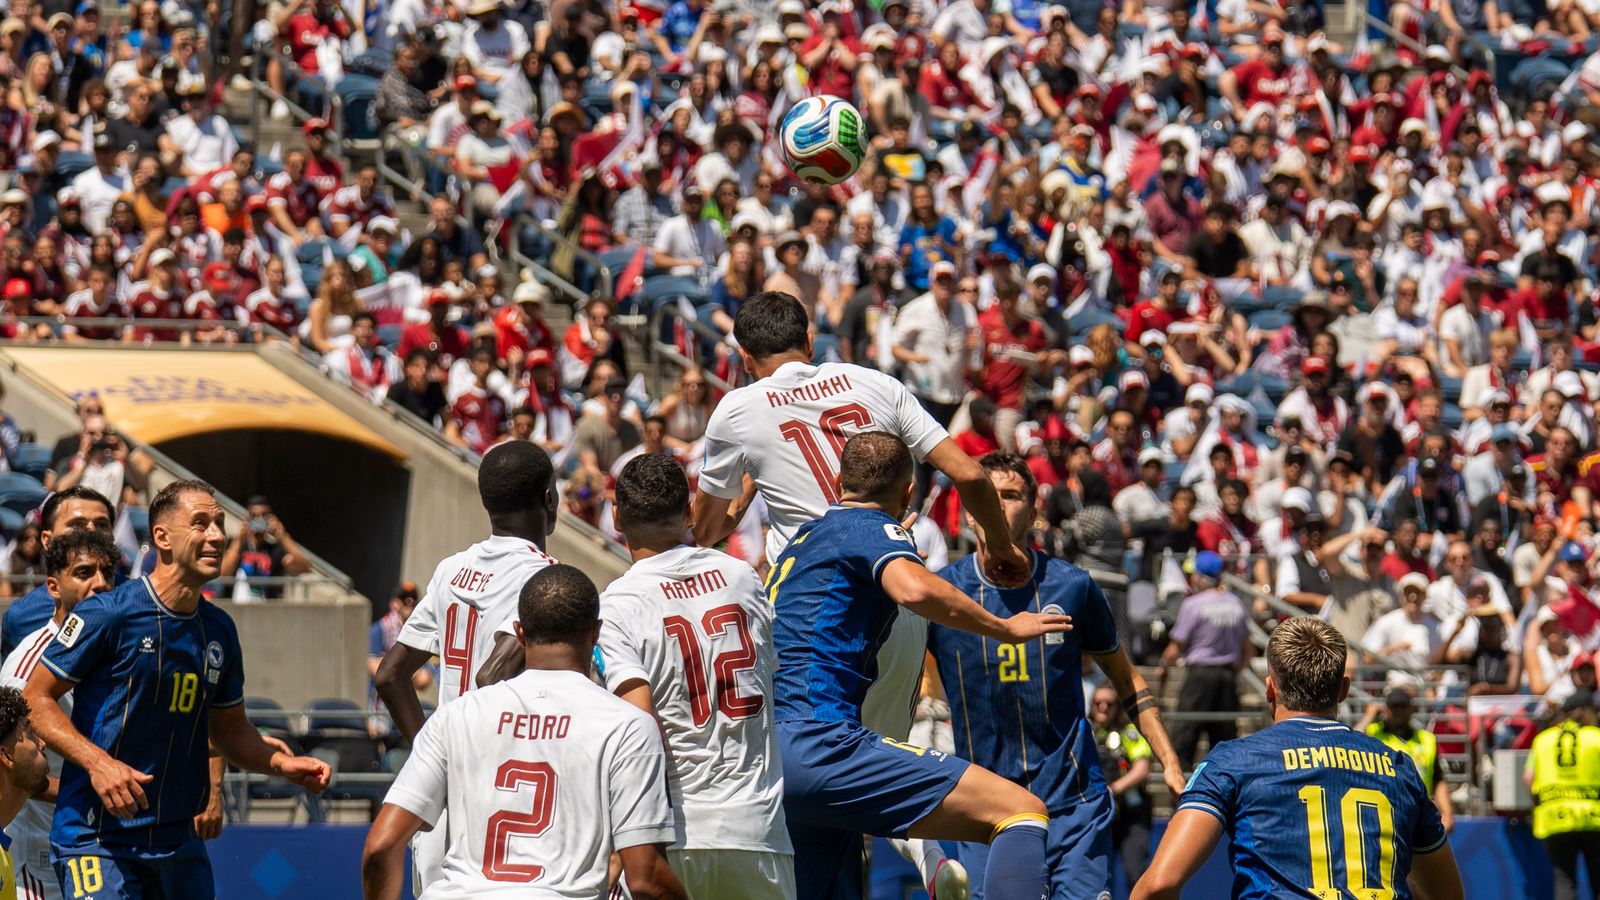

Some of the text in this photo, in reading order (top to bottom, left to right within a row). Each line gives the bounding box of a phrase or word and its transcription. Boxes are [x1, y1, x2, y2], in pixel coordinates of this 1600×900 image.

[450, 567, 494, 593] GUEYE
[660, 569, 728, 600] KARIM
[444, 602, 479, 697] 4
[663, 603, 767, 729] 12
[997, 643, 1030, 683] 21
[169, 672, 199, 713] 18
[497, 711, 571, 740] PEDRO
[1282, 746, 1396, 777] DEMIROVIĆ
[482, 759, 559, 884] 2
[1298, 785, 1398, 900] 10
[67, 855, 104, 898] 18
